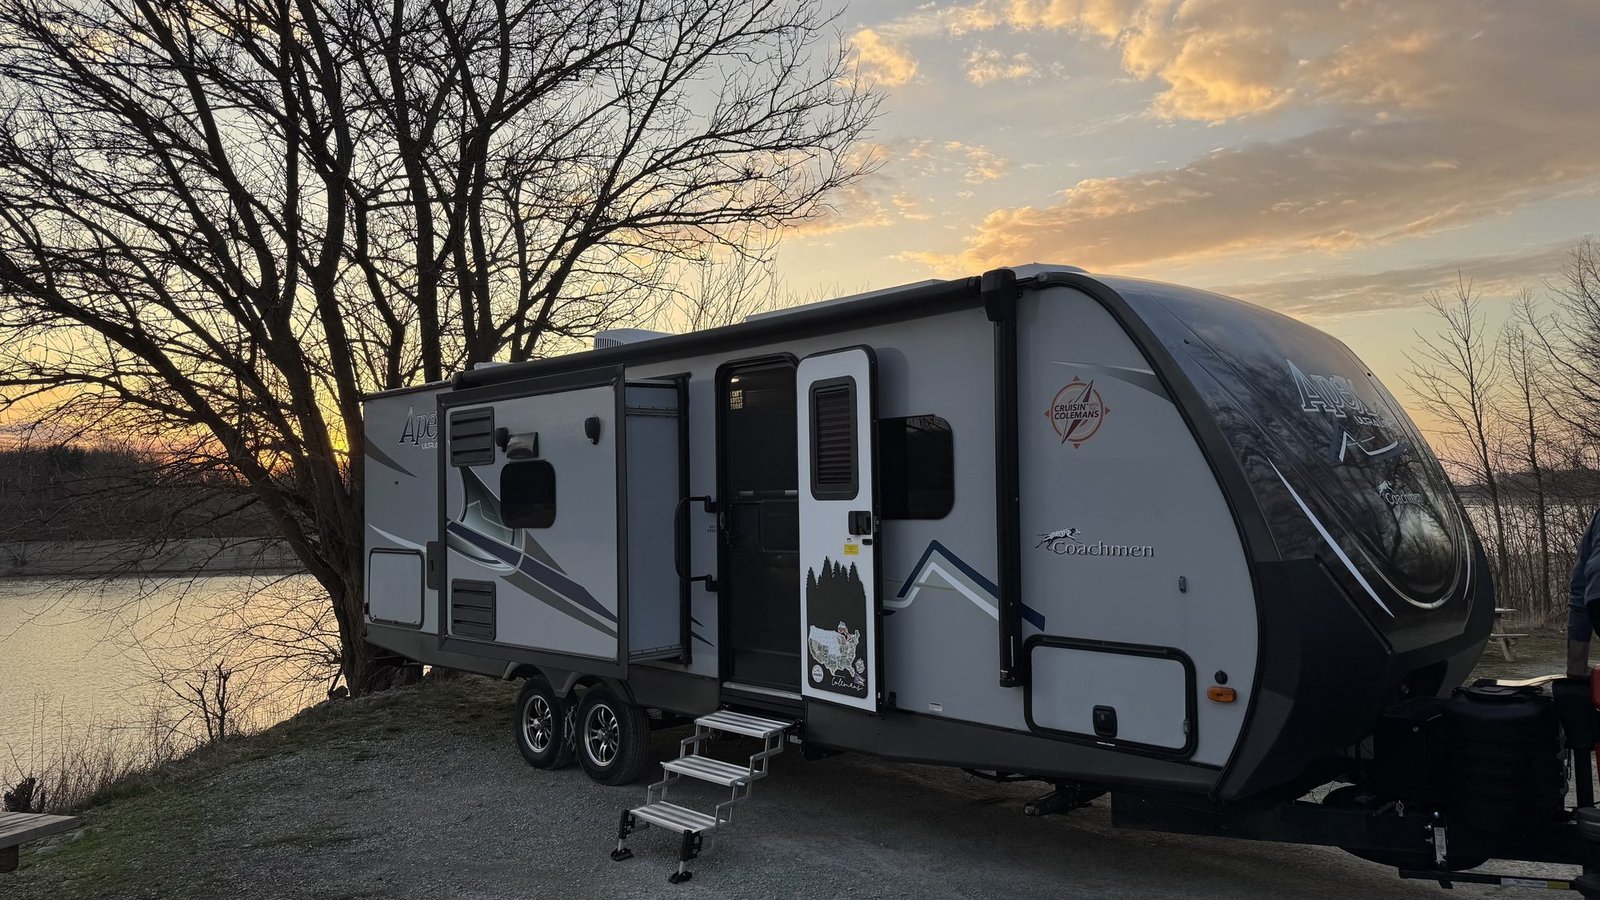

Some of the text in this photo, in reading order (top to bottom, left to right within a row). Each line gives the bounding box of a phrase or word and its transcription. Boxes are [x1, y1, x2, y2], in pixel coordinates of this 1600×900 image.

[1054, 403, 1089, 412] CRUISIN'
[1054, 410, 1099, 420] COLEMANS
[398, 405, 438, 447] Ape
[1052, 540, 1155, 558] Coachmen
